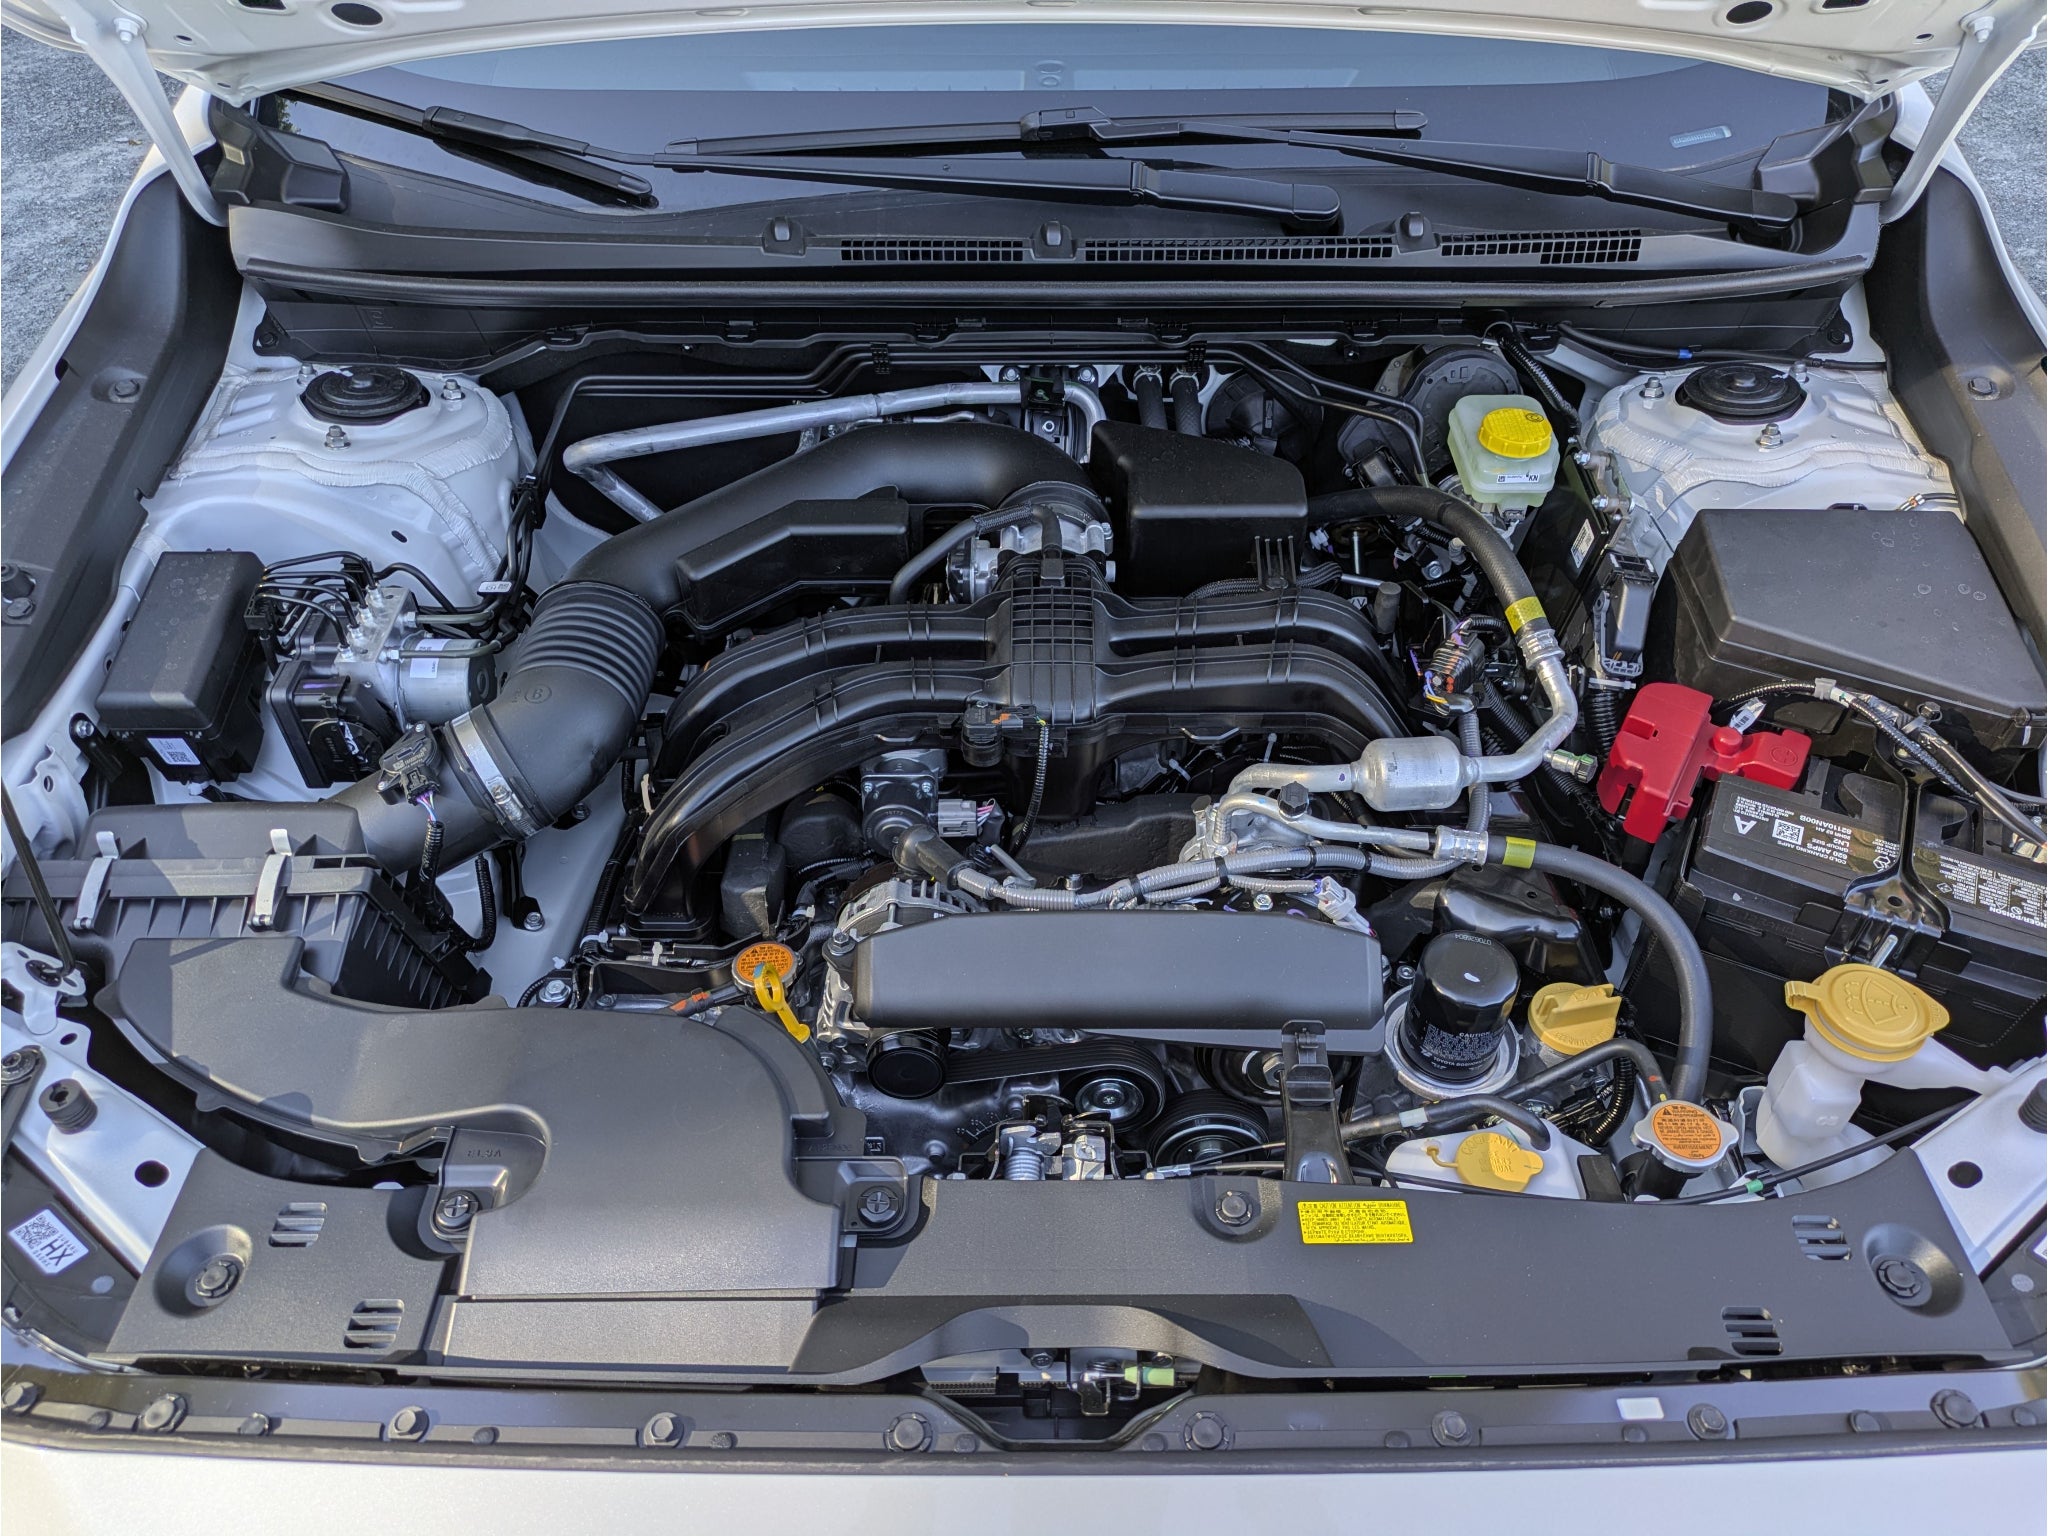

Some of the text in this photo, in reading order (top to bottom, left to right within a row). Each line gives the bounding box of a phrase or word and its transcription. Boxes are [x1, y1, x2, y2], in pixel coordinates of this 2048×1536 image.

[1827, 843, 1849, 852] GROUP
[1833, 837, 1850, 847] LN2
[1796, 846, 1829, 859] CRANKING
[1807, 843, 1848, 860] 620 AMPS
[1829, 856, 1847, 865] COLD
[1461, 1134, 1518, 1156] COOLANT
[41, 1238, 73, 1266] HX
